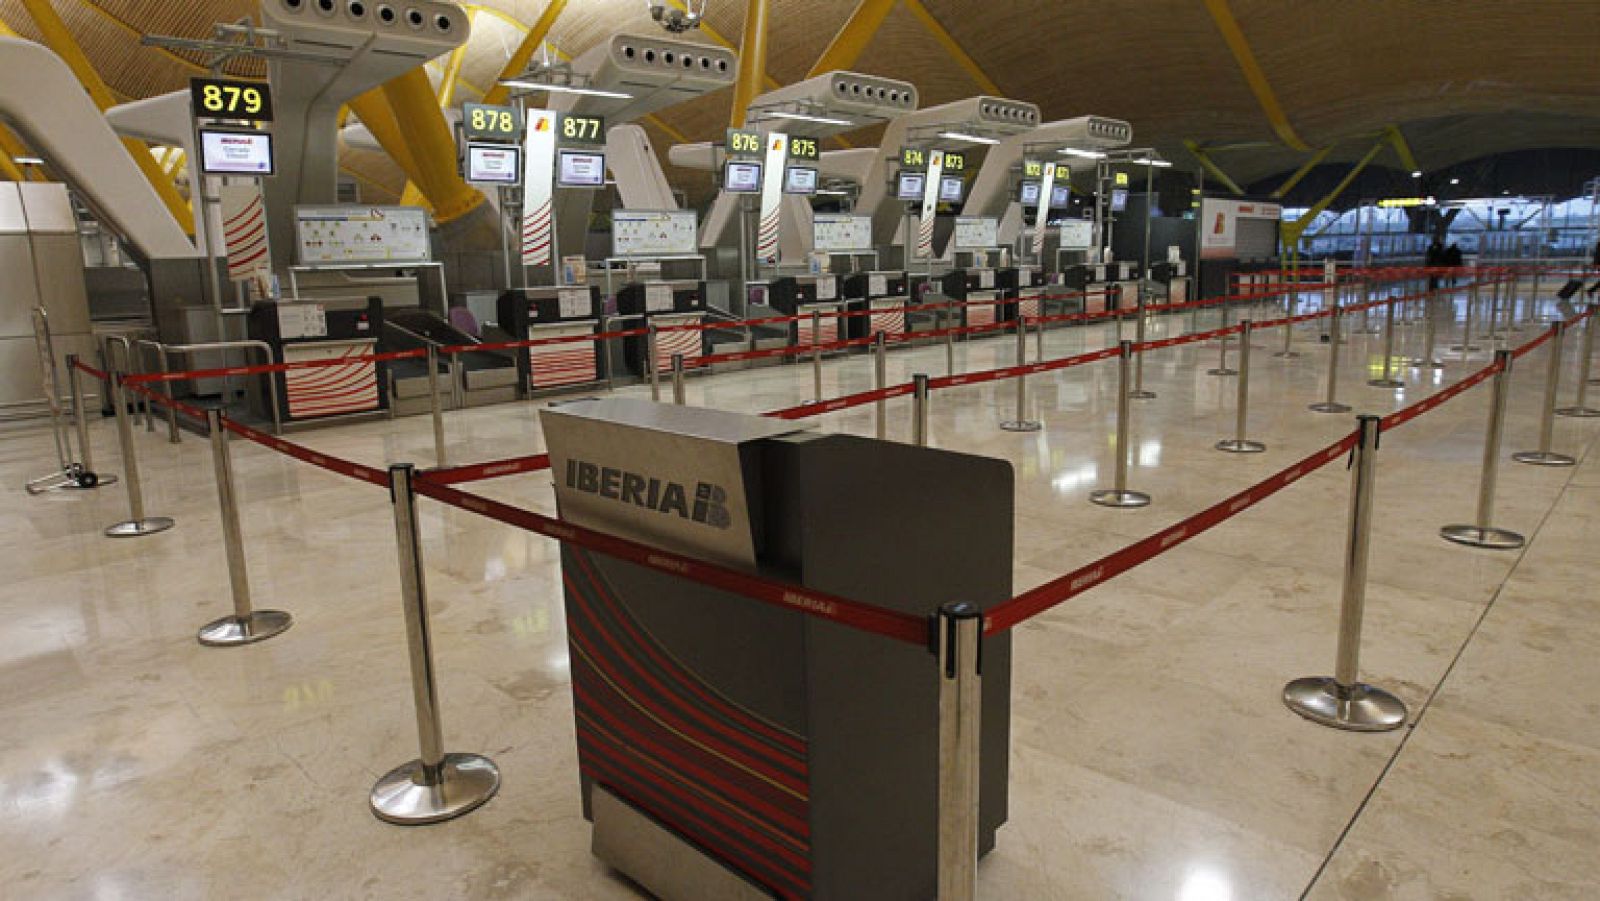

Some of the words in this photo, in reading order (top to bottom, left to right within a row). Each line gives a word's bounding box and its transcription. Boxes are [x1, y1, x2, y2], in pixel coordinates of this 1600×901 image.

[203, 84, 262, 113] 879
[472, 108, 513, 132] 878
[563, 117, 600, 138] 877
[732, 132, 759, 152] 876
[791, 139, 816, 156] 875
[566, 458, 689, 520] IBERIA
